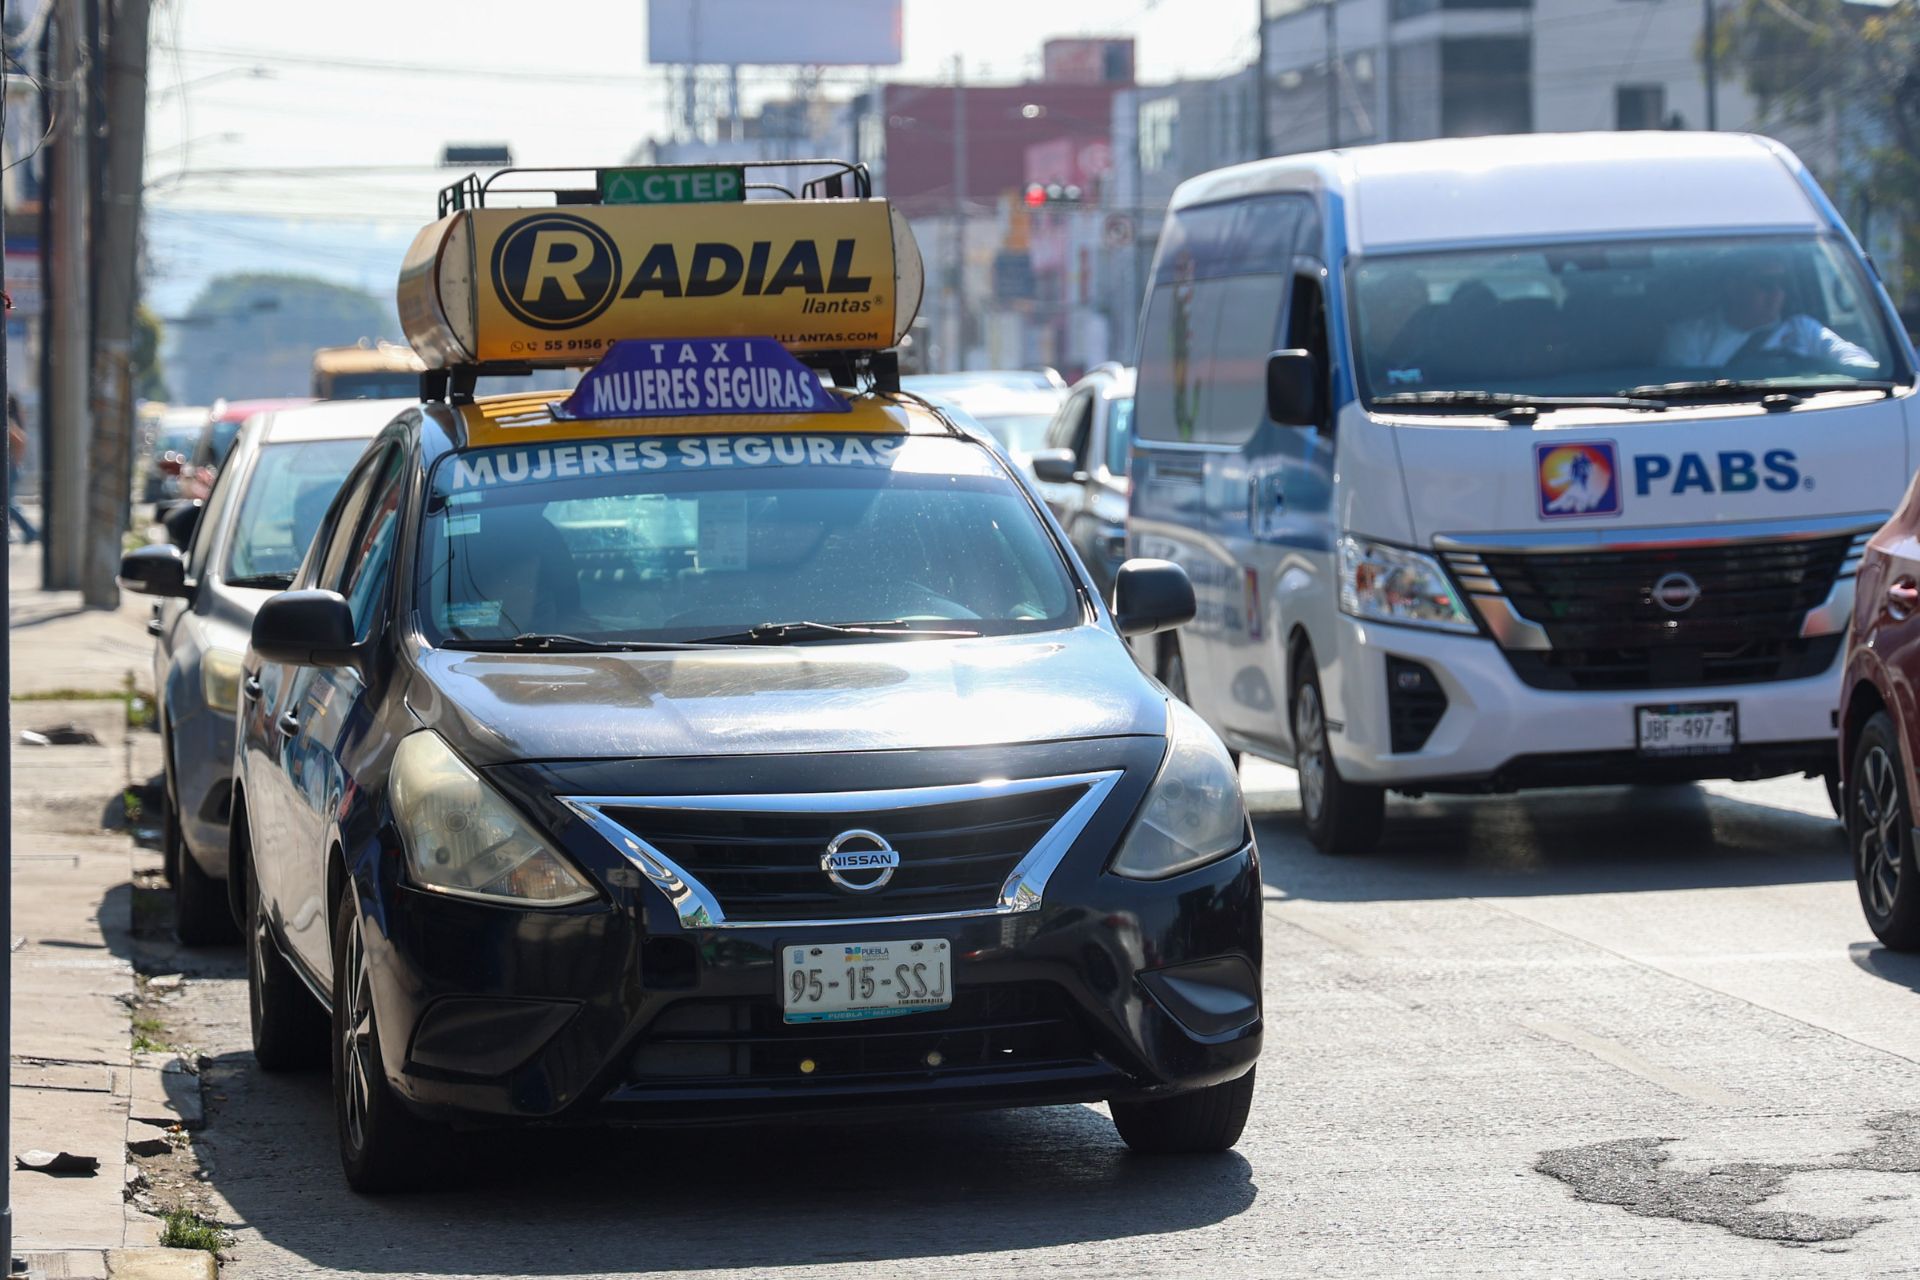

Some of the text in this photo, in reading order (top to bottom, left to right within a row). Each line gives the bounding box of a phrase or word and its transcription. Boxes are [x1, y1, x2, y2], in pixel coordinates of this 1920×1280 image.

[643, 172, 736, 200] CTEP
[522, 231, 872, 301] RADIAL
[544, 340, 563, 350] 55
[568, 339, 602, 350] 9156
[650, 342, 752, 363] TAXI
[592, 366, 815, 413] MUJERES SEGURAS
[453, 437, 896, 490] MUJERES SEGURAS
[830, 854, 892, 866] NISSAN
[861, 947, 889, 955] PUEBLA
[791, 962, 945, 1003] 95-15-SSJ
